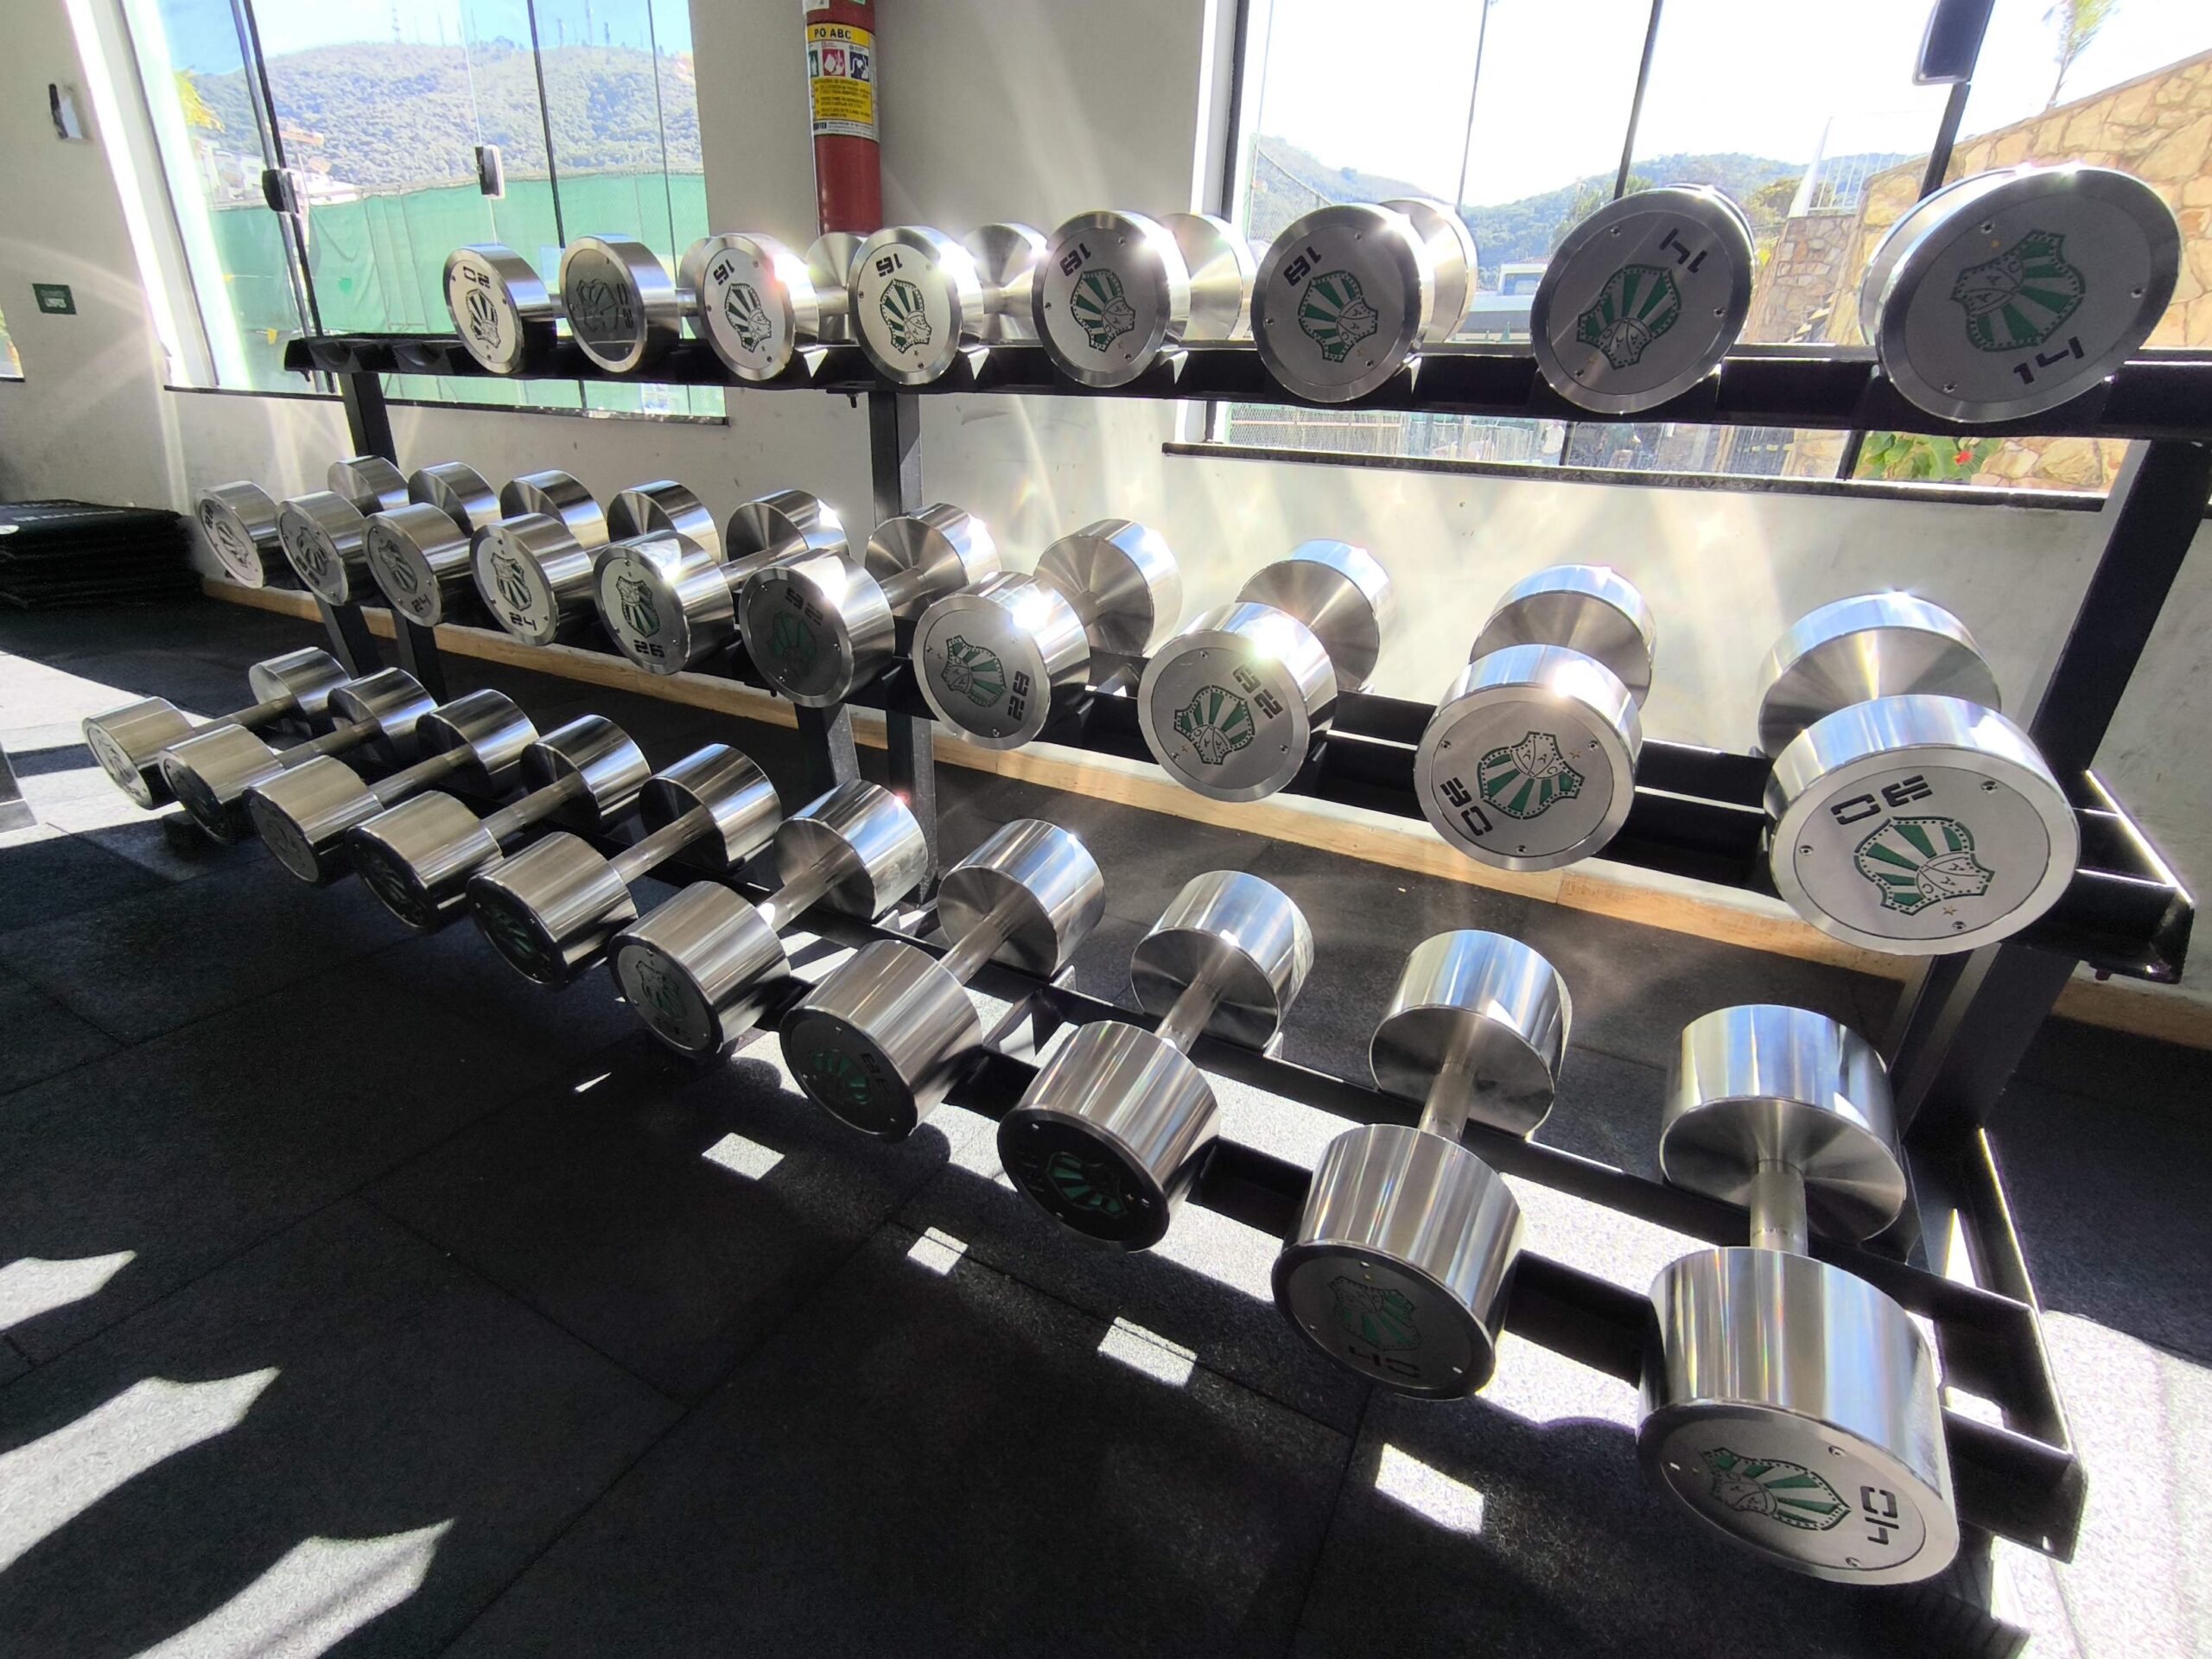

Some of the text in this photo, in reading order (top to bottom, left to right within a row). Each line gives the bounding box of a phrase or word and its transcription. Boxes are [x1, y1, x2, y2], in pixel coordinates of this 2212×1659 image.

[830, 28, 851, 39] ABC
[1059, 243, 1091, 276] 18
[1283, 245, 1321, 286] 18
[1656, 228, 1707, 274] 14
[463, 265, 491, 289] 20
[2013, 336, 2085, 385] 14
[410, 594, 431, 613] 24
[508, 612, 537, 631] 24
[632, 639, 664, 658] 26
[1007, 671, 1030, 722] 28
[1231, 665, 1283, 720] 28
[1440, 777, 1493, 836] 30
[1831, 774, 1932, 826] 30
[1859, 1485, 1899, 1546] 40
